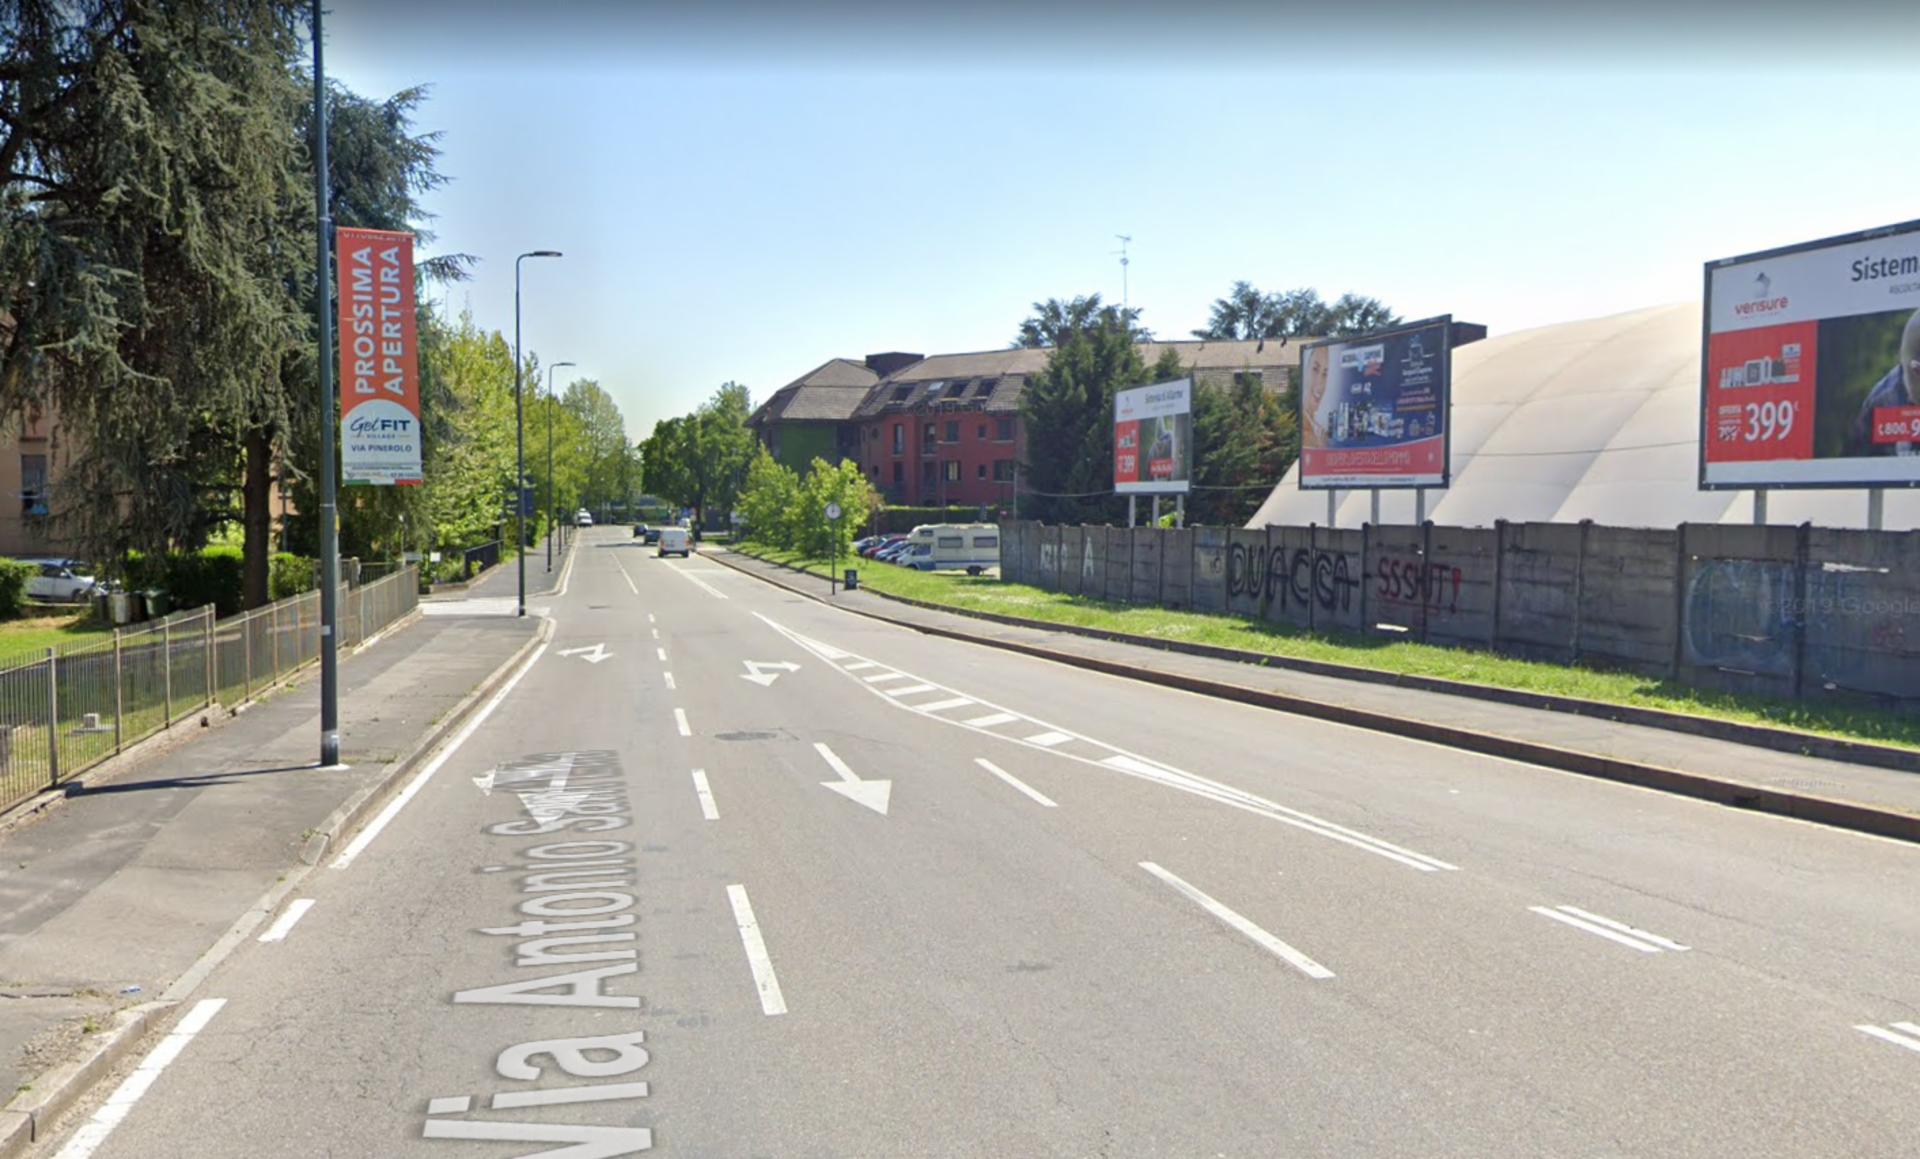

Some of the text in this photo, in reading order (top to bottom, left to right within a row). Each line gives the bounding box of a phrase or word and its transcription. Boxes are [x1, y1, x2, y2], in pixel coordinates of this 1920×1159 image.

[1851, 255, 1920, 282] Sistem
[351, 245, 376, 394] PROSSIMA
[379, 246, 404, 396] APERTURA
[351, 444, 413, 453] VIA PINEROLO
